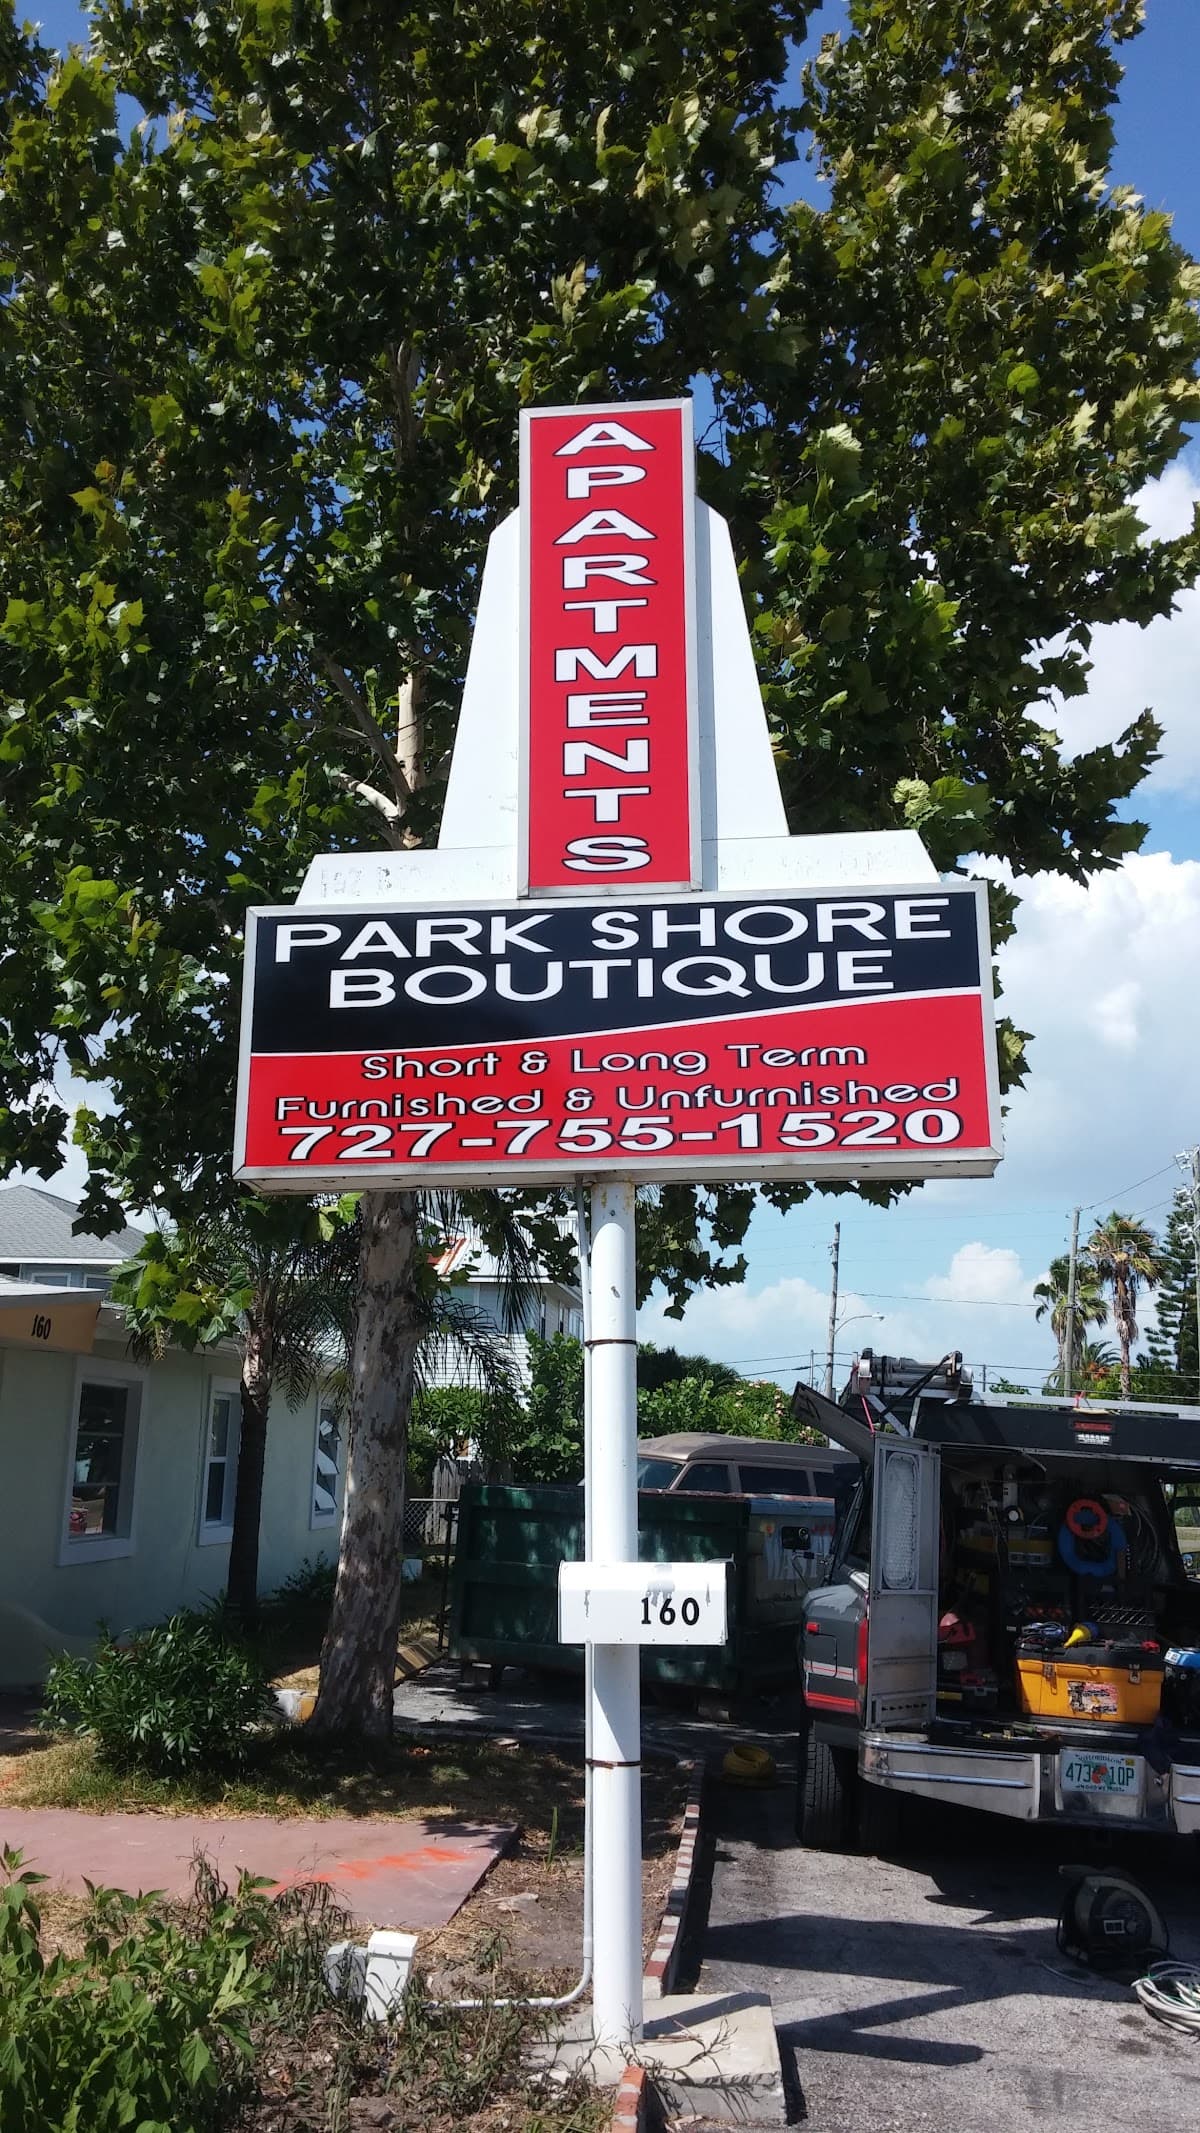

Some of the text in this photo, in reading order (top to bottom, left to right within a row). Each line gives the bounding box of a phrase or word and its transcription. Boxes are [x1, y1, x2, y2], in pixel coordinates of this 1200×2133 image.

[553, 421, 657, 873] APARTMENTS
[274, 897, 952, 964] PARK SHORE
[329, 949, 895, 1010] BOUTIQUE
[361, 1043, 868, 1080] Short & Long Term
[274, 1076, 960, 1122] Furnished & Unfurnished
[278, 1106, 964, 1161] 727-755-1520
[31, 1313, 52, 1340] 160
[640, 1597, 700, 1626] 160
[1065, 1762, 1092, 1784] 473
